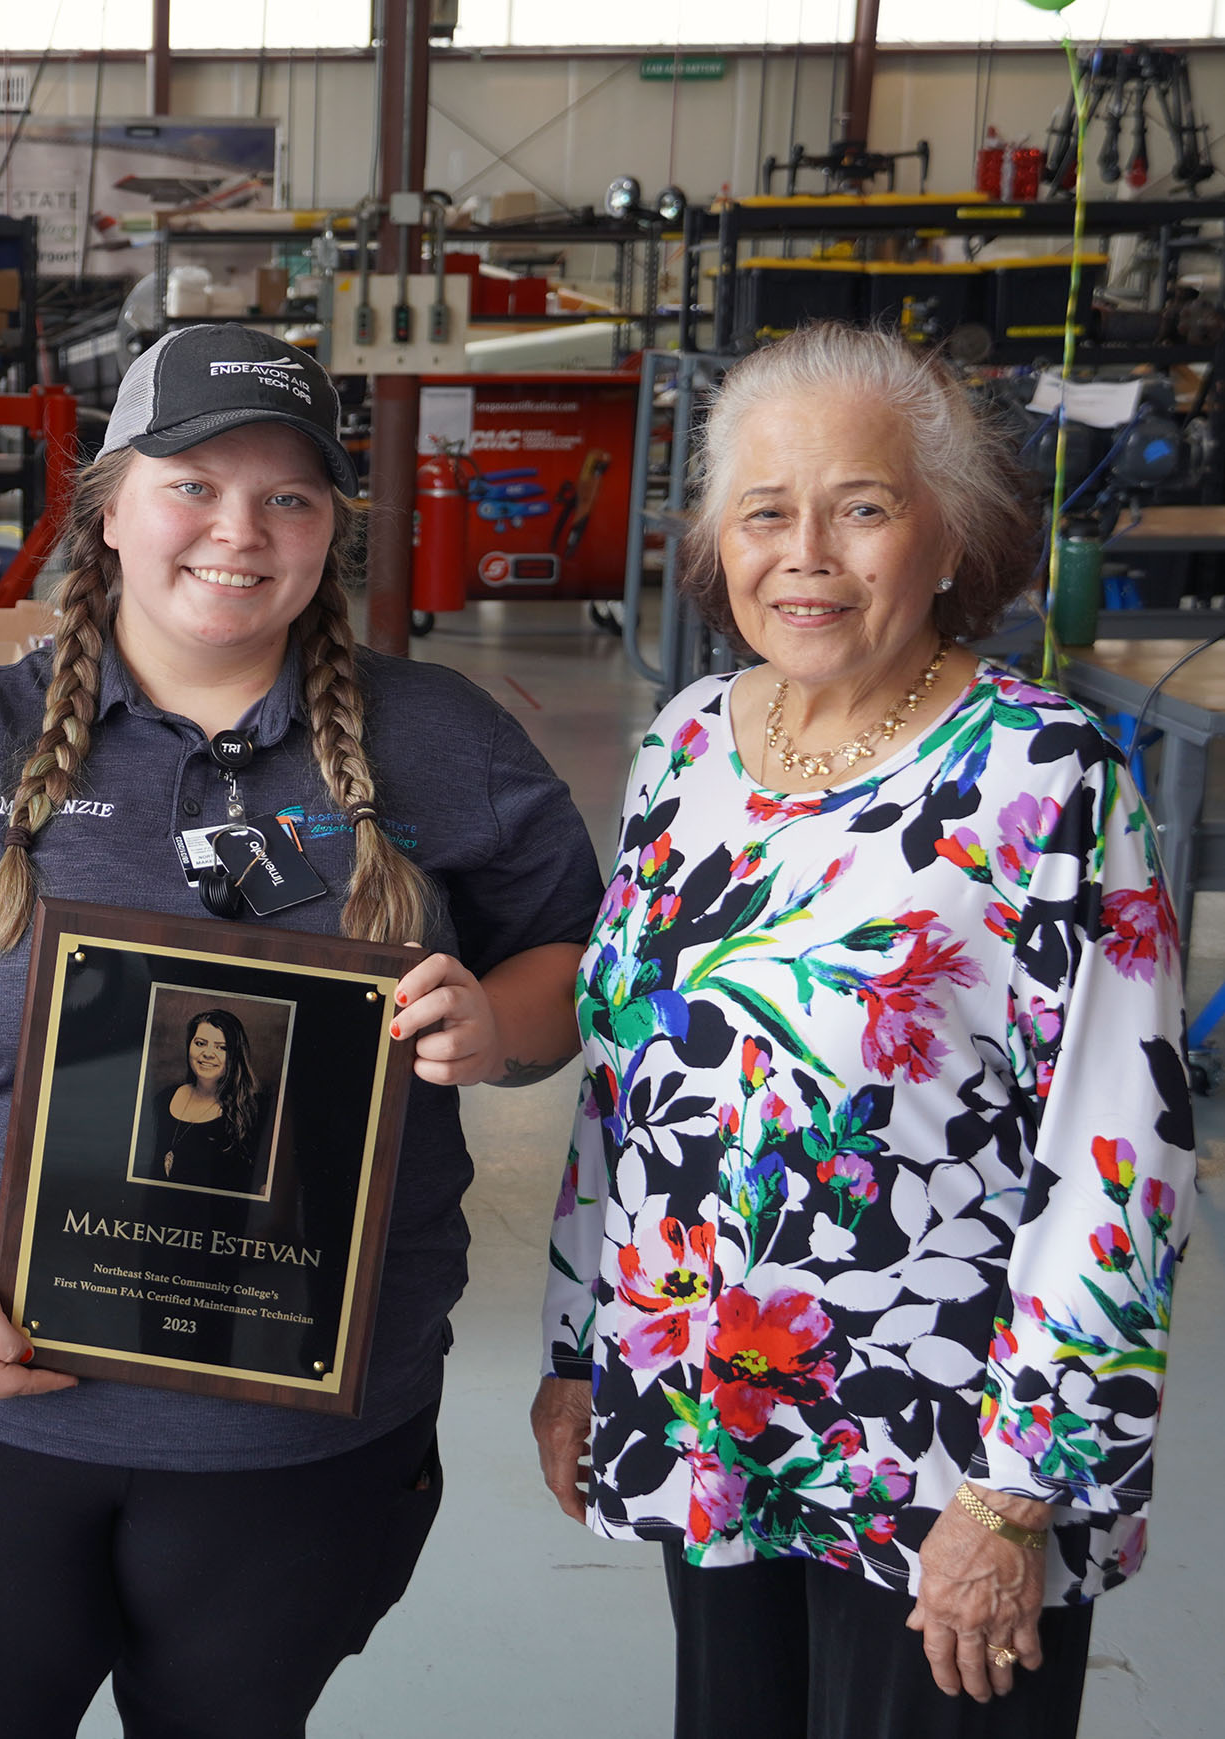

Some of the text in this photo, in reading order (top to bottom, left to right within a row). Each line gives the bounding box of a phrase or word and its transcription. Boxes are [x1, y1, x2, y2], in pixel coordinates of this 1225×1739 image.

[210, 364, 310, 393] ENDEAVOR AIR
[258, 376, 312, 405] TECH OPS
[221, 742, 242, 753] TRI
[93, 1263, 279, 1300] Northeast State Community College's
[53, 1276, 314, 1325] First Woman FAA Certified Maintenance Technician
[162, 1316, 197, 1334] 2023
